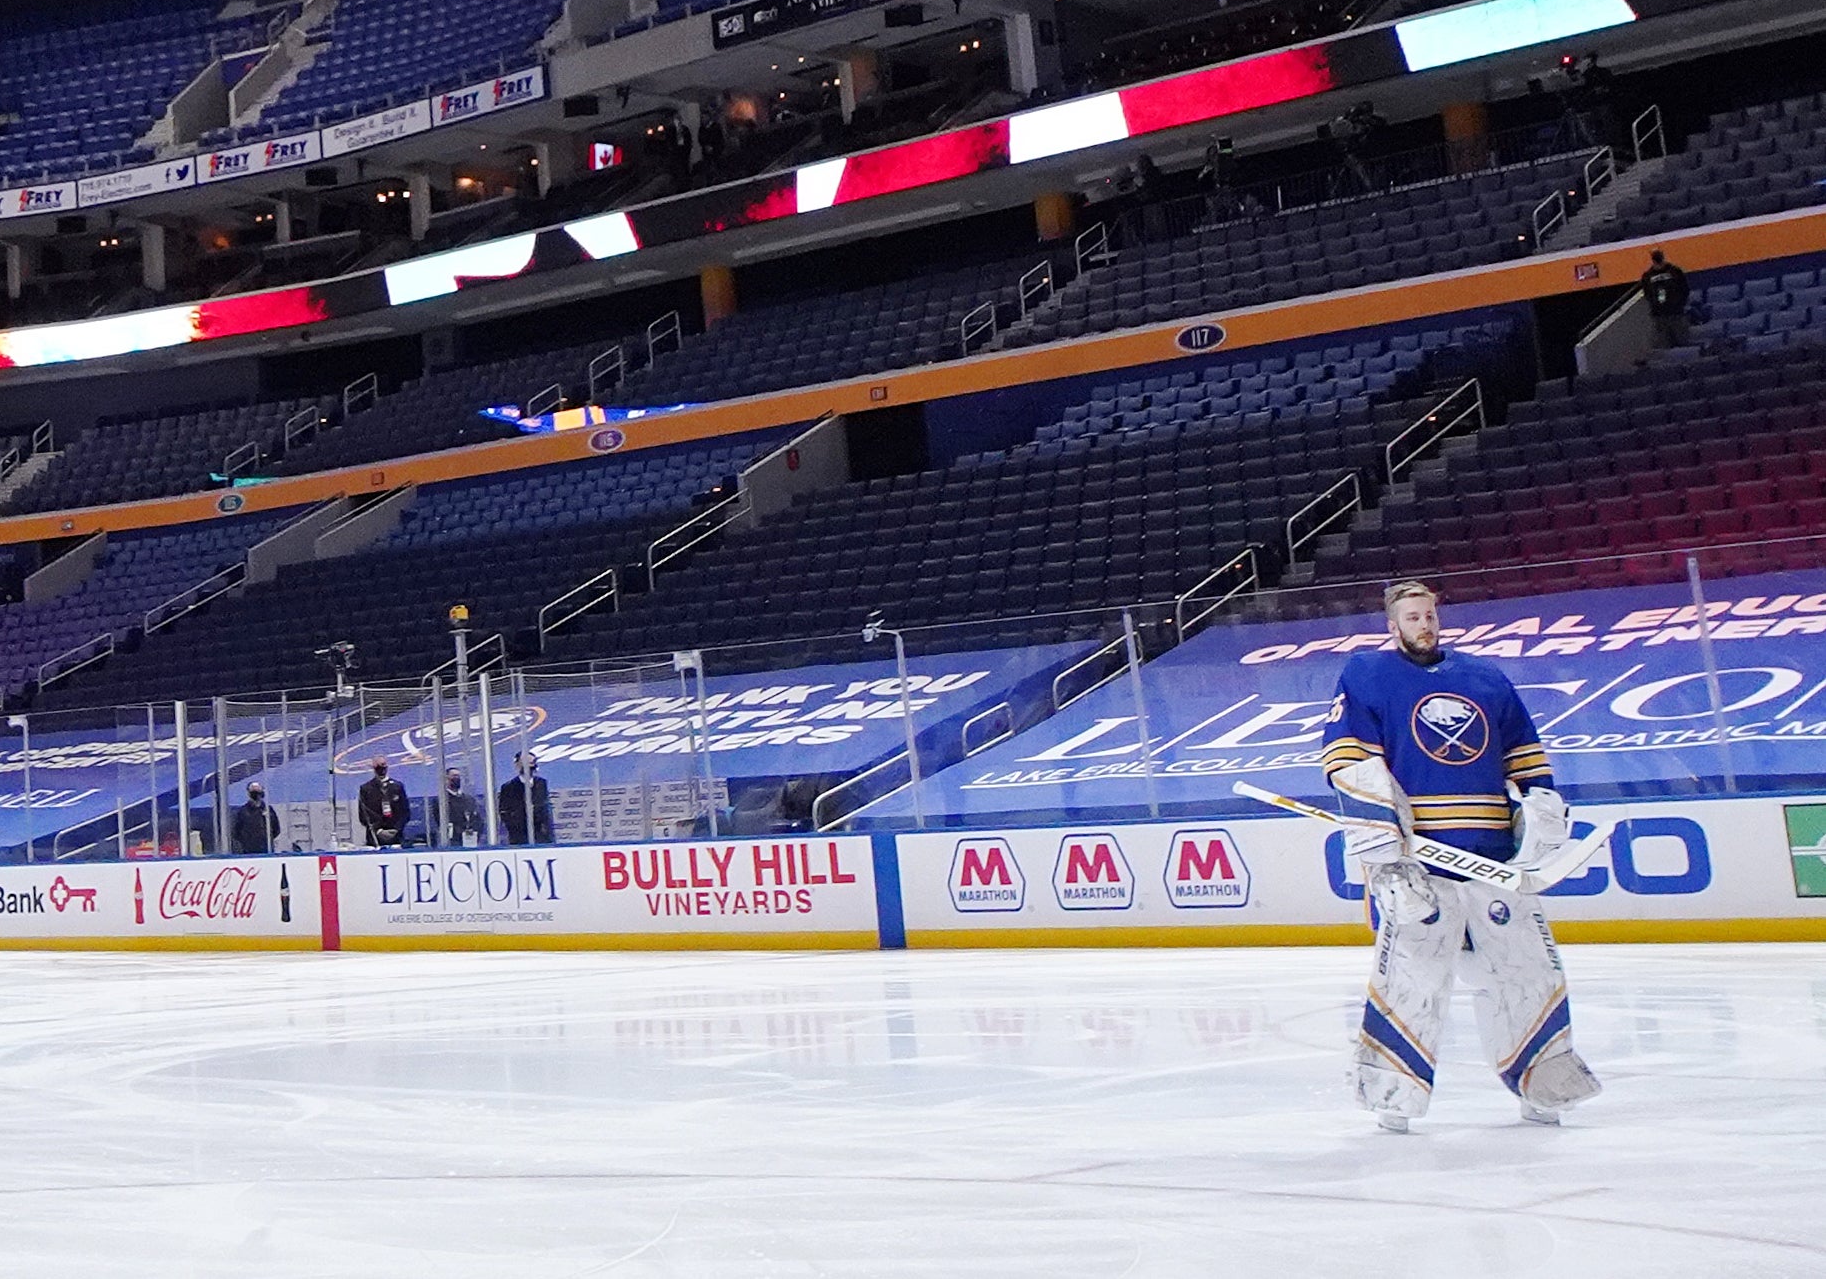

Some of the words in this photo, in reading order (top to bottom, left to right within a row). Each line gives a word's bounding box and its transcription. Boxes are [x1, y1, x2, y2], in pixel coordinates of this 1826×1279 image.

[498, 75, 534, 97] FREY
[215, 152, 250, 170] FREY
[271, 140, 308, 159] FREY
[26, 189, 64, 207] FREY
[1190, 327, 1209, 347] 117
[597, 684, 835, 718] THANK
[837, 671, 991, 700] YOU
[535, 698, 938, 742] FRONTLINE
[530, 725, 864, 763] WORKERS
[974, 764, 1073, 787] LAKE
[1074, 758, 1154, 779] ERIE
[1165, 752, 1323, 773] COLLEG
[602, 846, 737, 891] BULLY
[752, 841, 857, 886] HILL
[960, 847, 1013, 887] M
[1065, 843, 1121, 884] M
[1176, 839, 1236, 881] M
[379, 857, 562, 905] LECOM
[958, 888, 1018, 903] MARATHON
[1063, 886, 1126, 901] MARATHON
[1175, 883, 1242, 899] MARATHON
[646, 889, 813, 917] VINEYARDS
